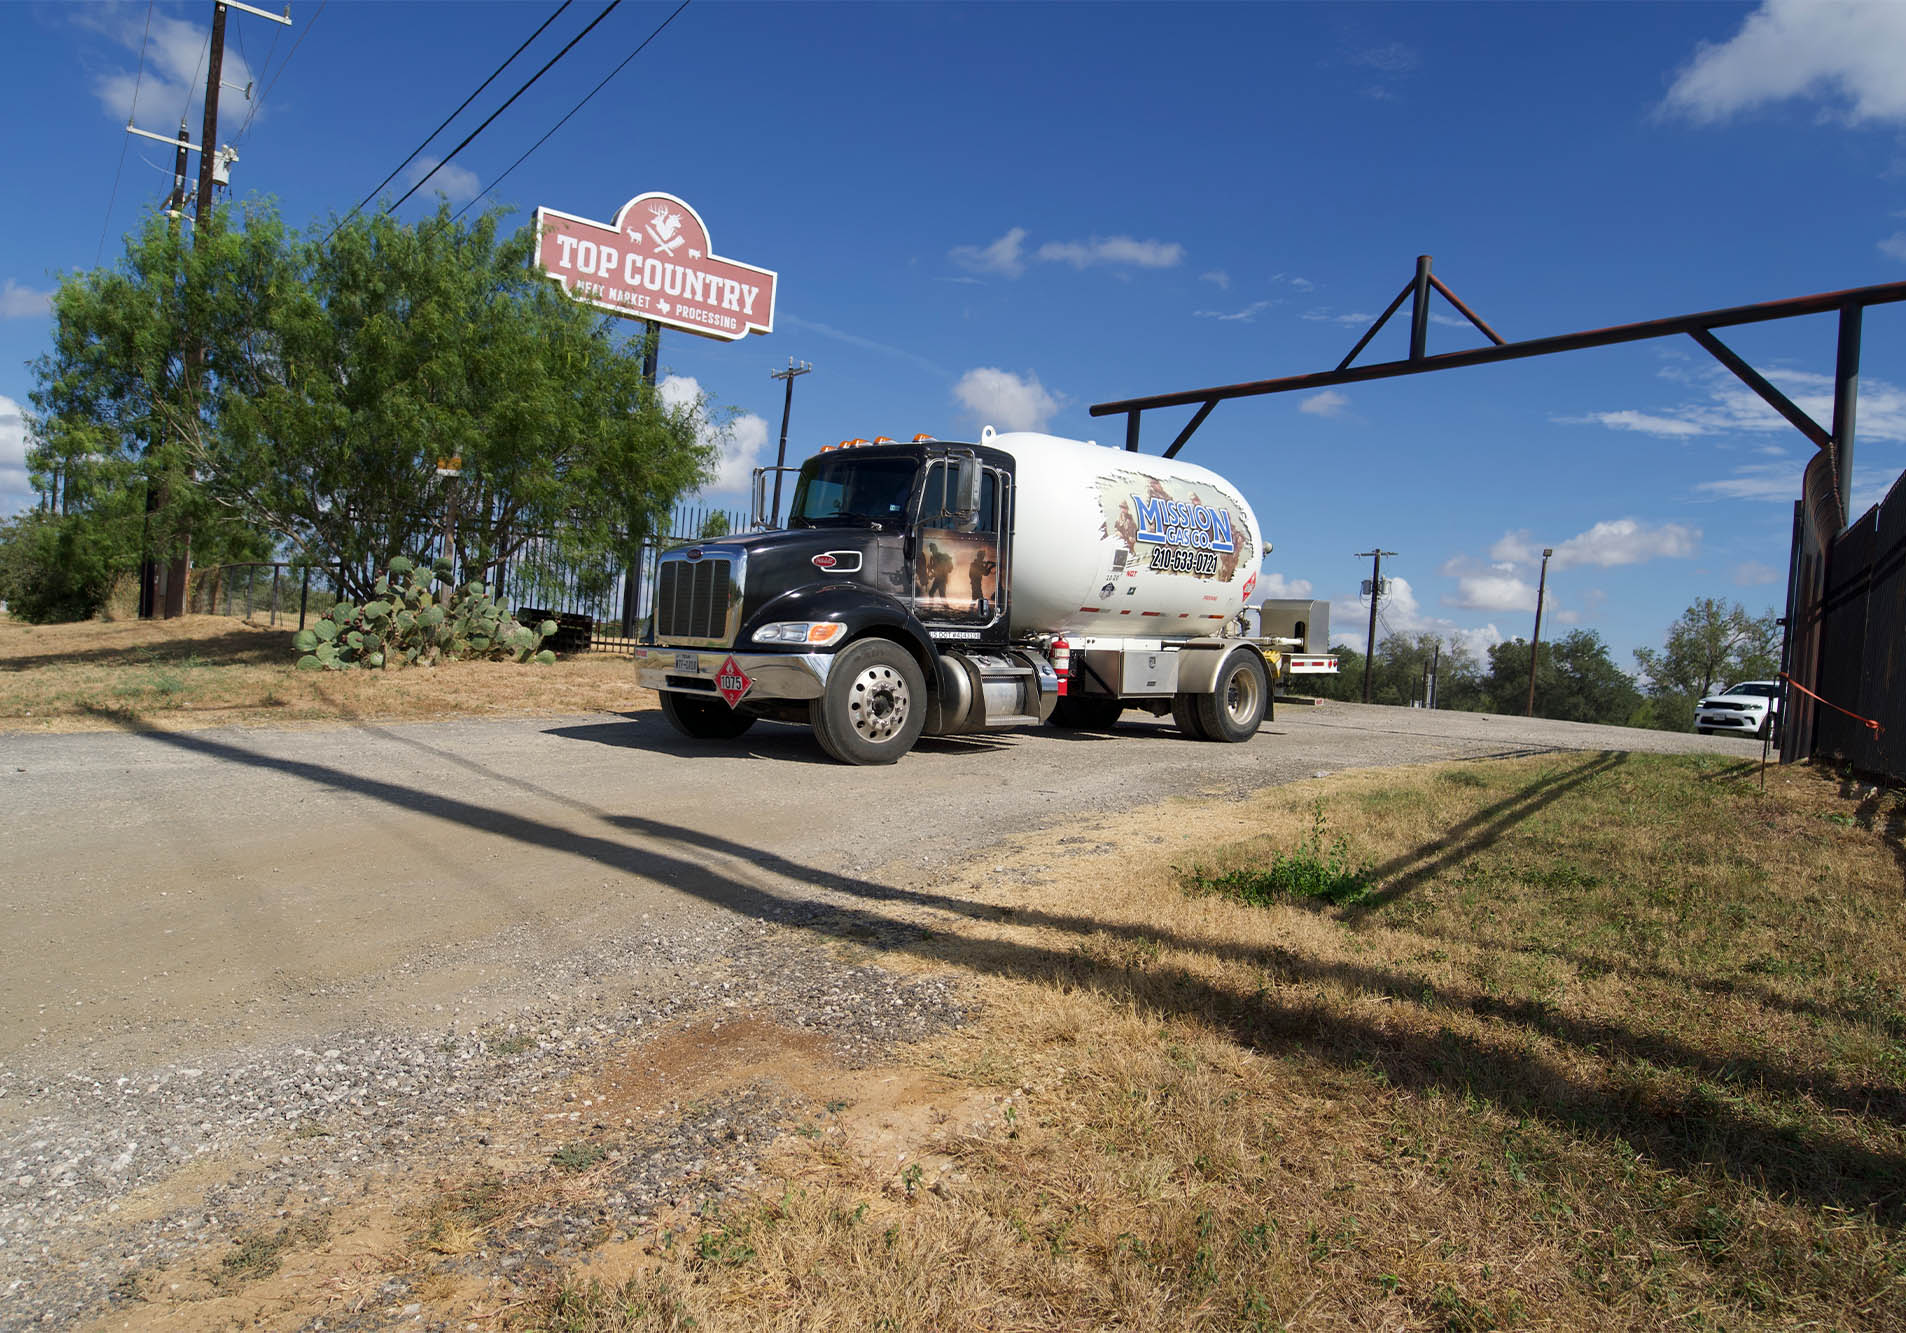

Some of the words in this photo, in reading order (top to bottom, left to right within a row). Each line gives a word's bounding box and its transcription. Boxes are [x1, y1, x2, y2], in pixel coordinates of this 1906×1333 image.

[557, 234, 619, 278] TOP
[624, 252, 759, 315] COUNTRY
[577, 279, 605, 297] MEAT
[608, 287, 651, 309] MARKET
[676, 303, 737, 330] PROCESSING
[1131, 494, 1234, 543] MISSION
[1166, 526, 1190, 546] GAS
[1191, 529, 1212, 549] CO.
[1151, 547, 1218, 574] 210-633-0721
[721, 676, 742, 690] 1075
